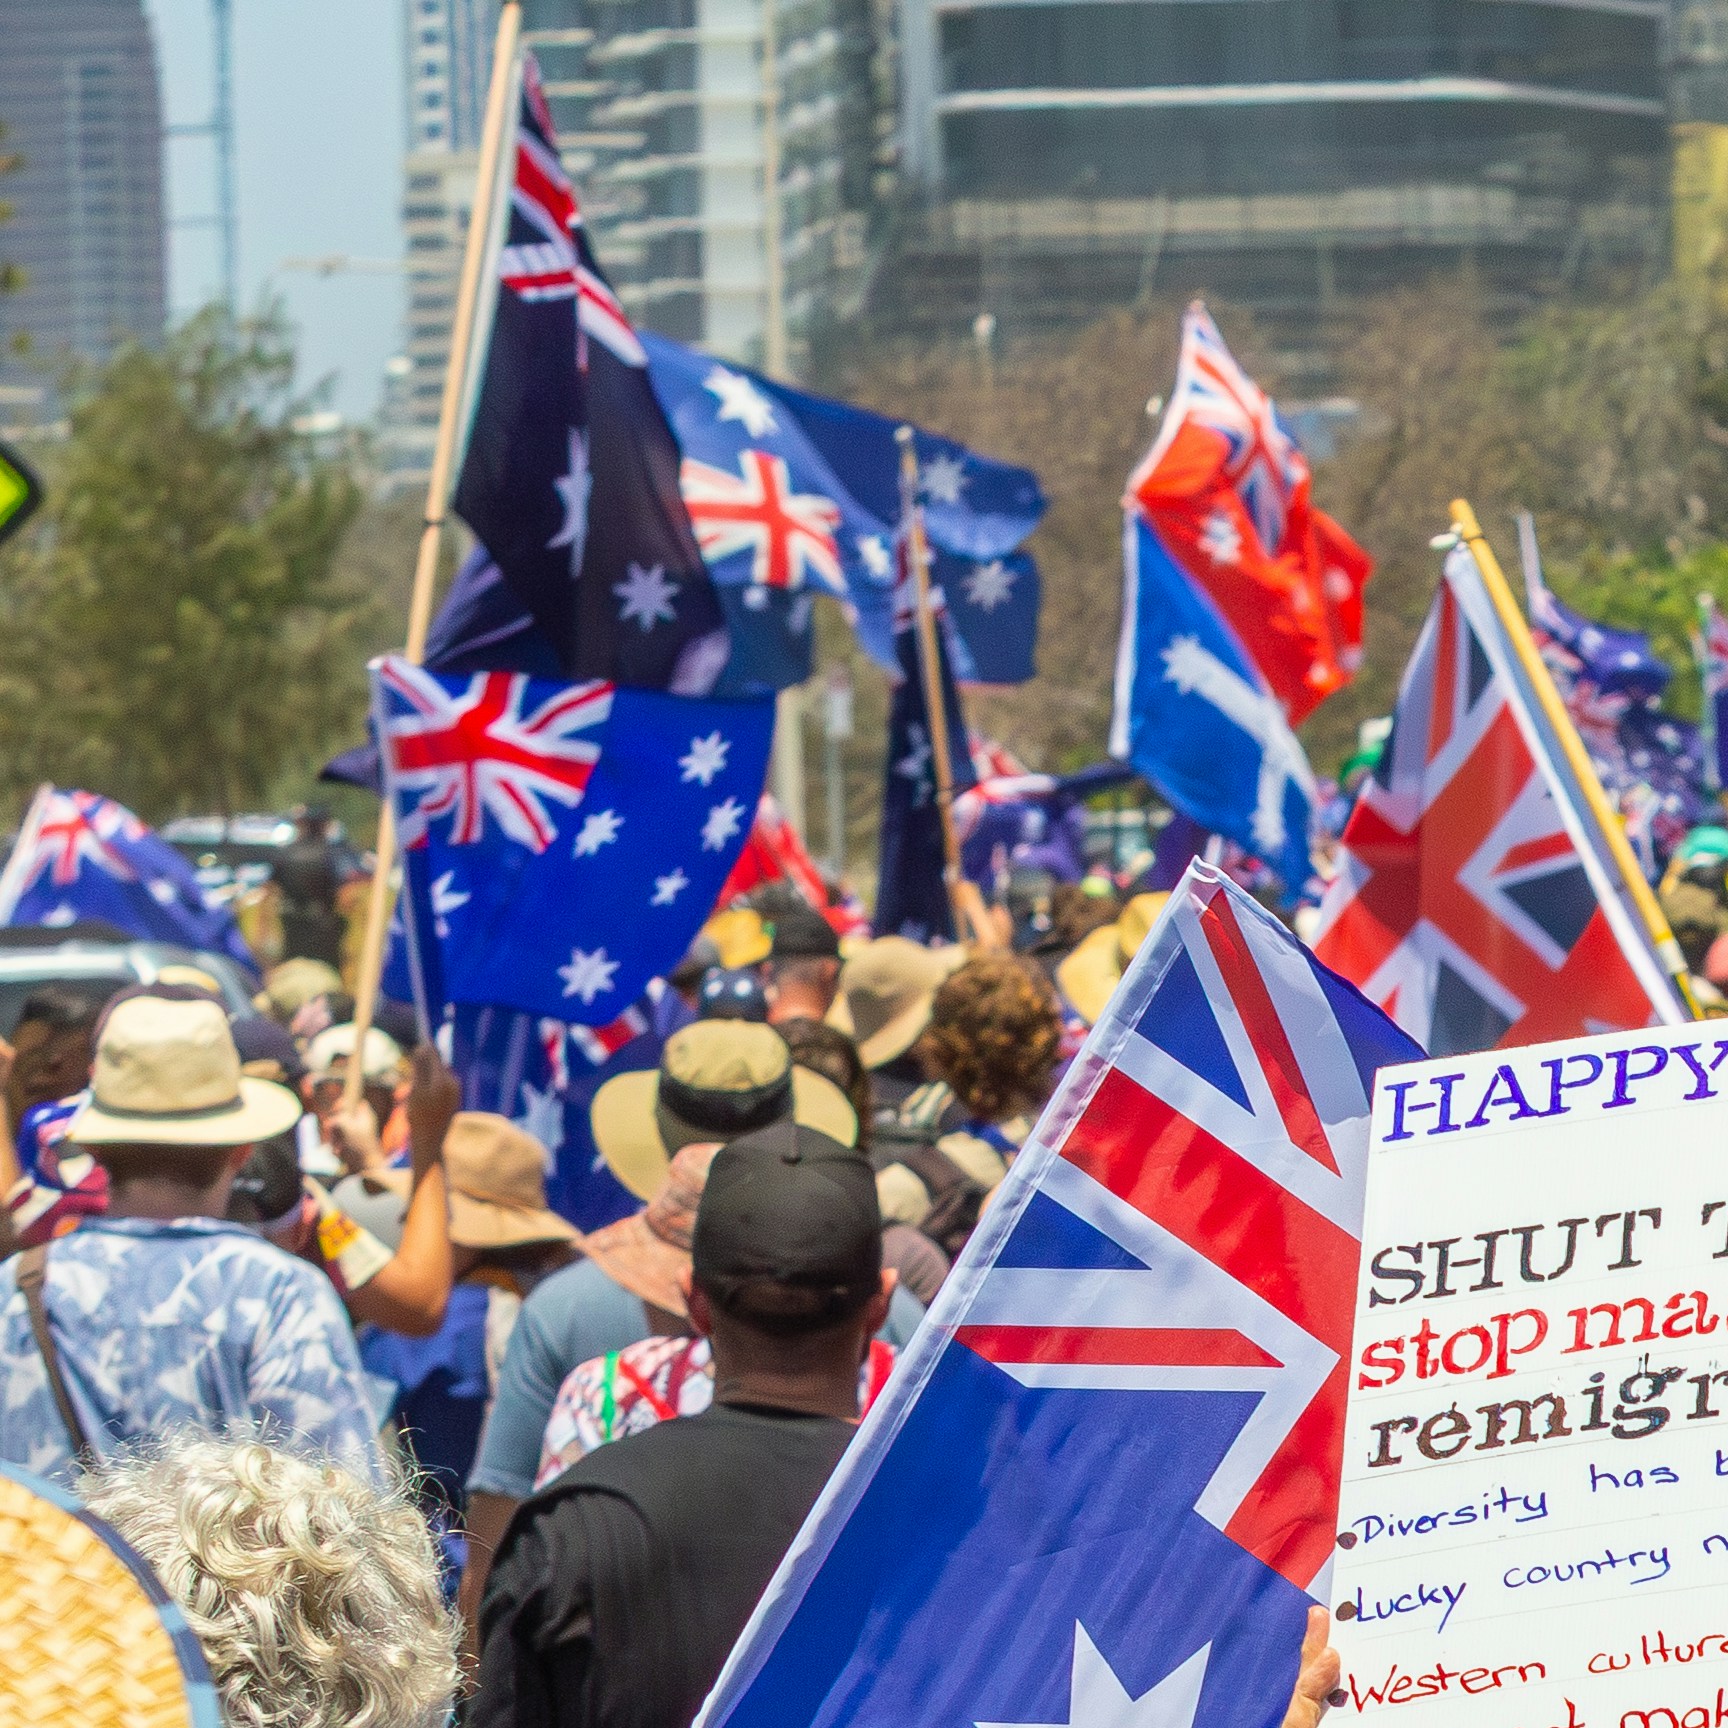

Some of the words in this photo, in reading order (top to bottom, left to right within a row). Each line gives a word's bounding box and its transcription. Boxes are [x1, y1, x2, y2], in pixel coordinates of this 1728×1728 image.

[1370, 1208, 1661, 1309] SHUT
[1359, 1287, 1548, 1390] stop
[1353, 1487, 1548, 1543] Diversity
[1590, 1464, 1679, 1491] has
[1351, 1583, 1466, 1633] Lucky
[1504, 1548, 1670, 1587] country
[1349, 1663, 1546, 1712] Western
